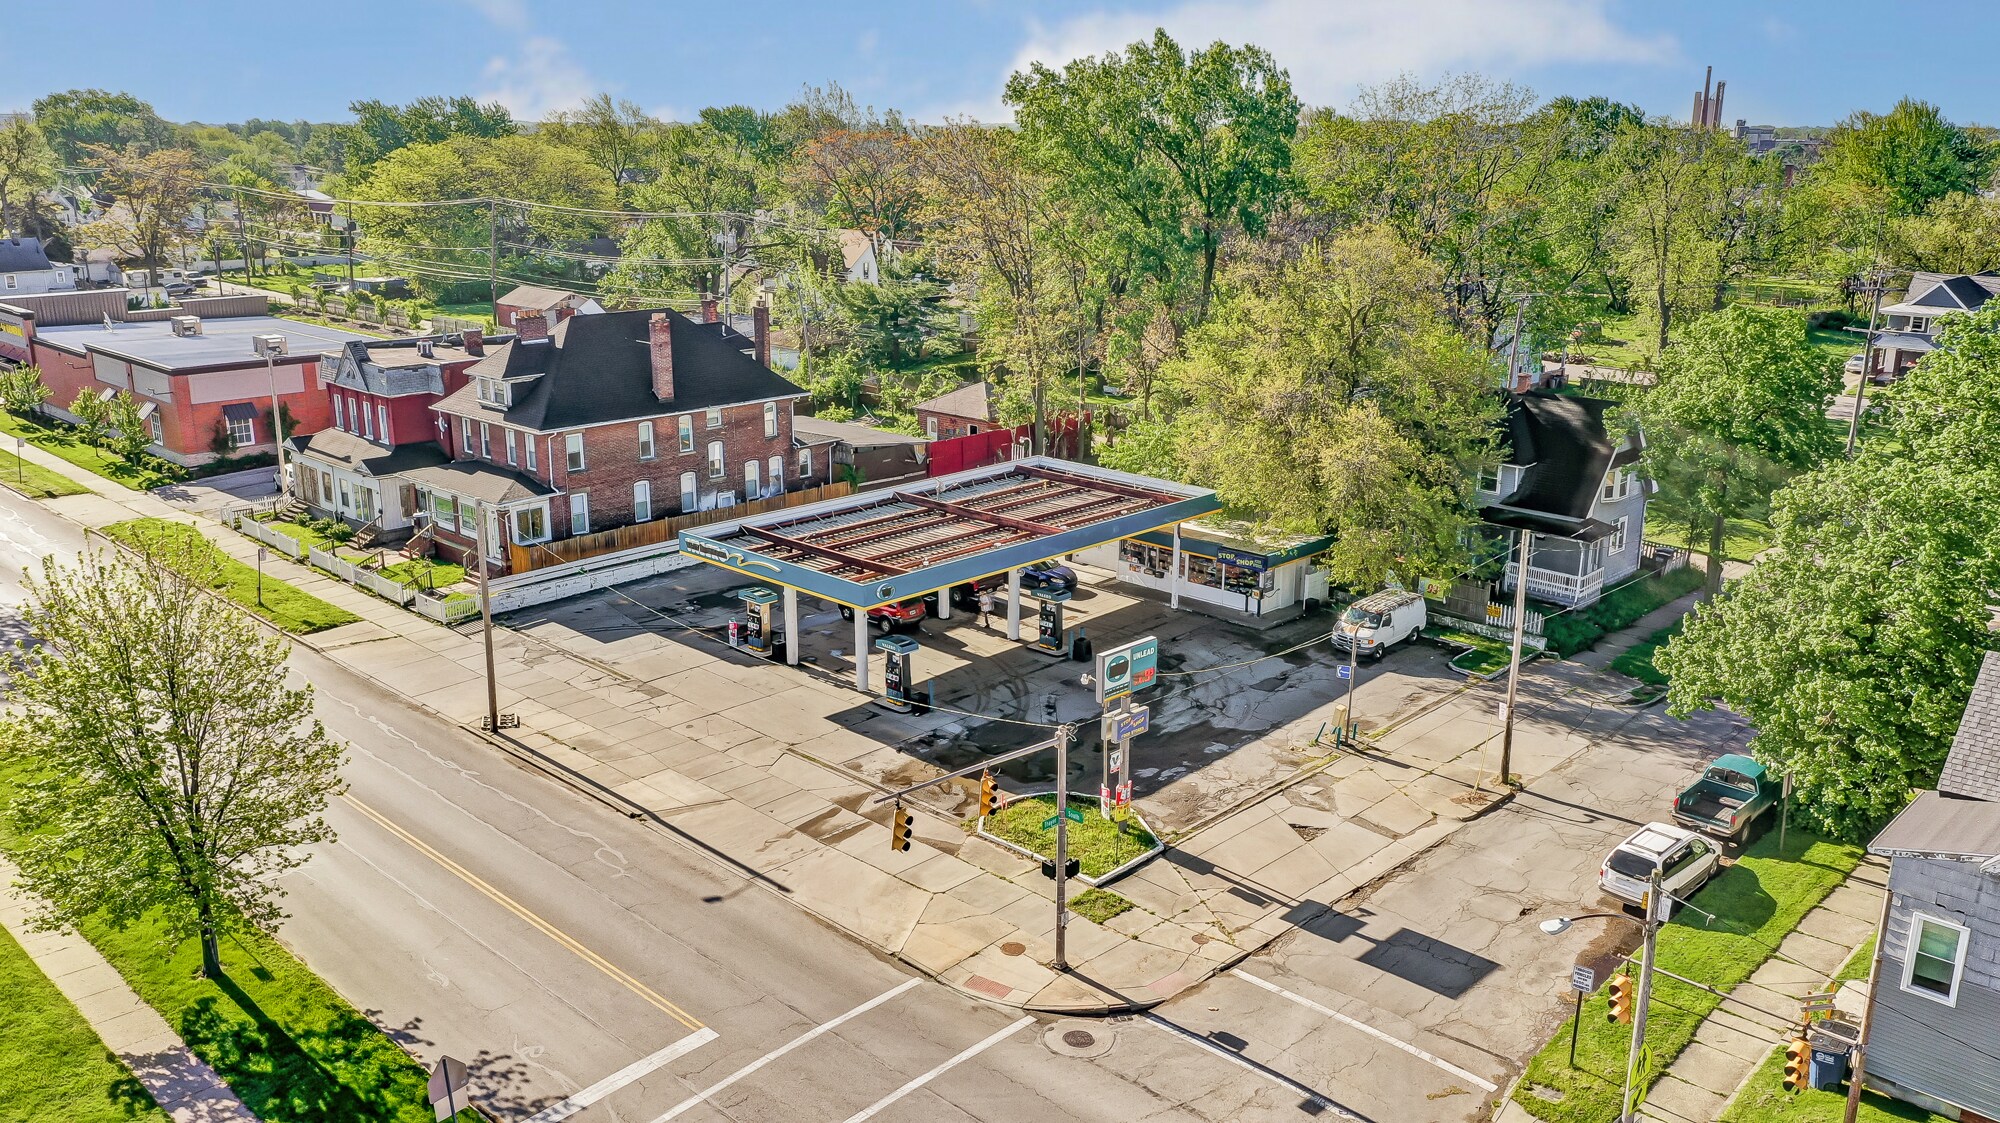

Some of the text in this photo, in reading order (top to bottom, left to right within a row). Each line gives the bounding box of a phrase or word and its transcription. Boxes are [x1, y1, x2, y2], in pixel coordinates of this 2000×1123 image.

[1236, 559, 1253, 567] SHOP
[1036, 592, 1052, 600] VALERO
[881, 642, 896, 651] VALERO
[1133, 647, 1155, 660] UNLEAD
[1068, 810, 1080, 820] South
[1575, 966, 1592, 974] THROUGH
[1575, 971, 1592, 979] VEHICLES
